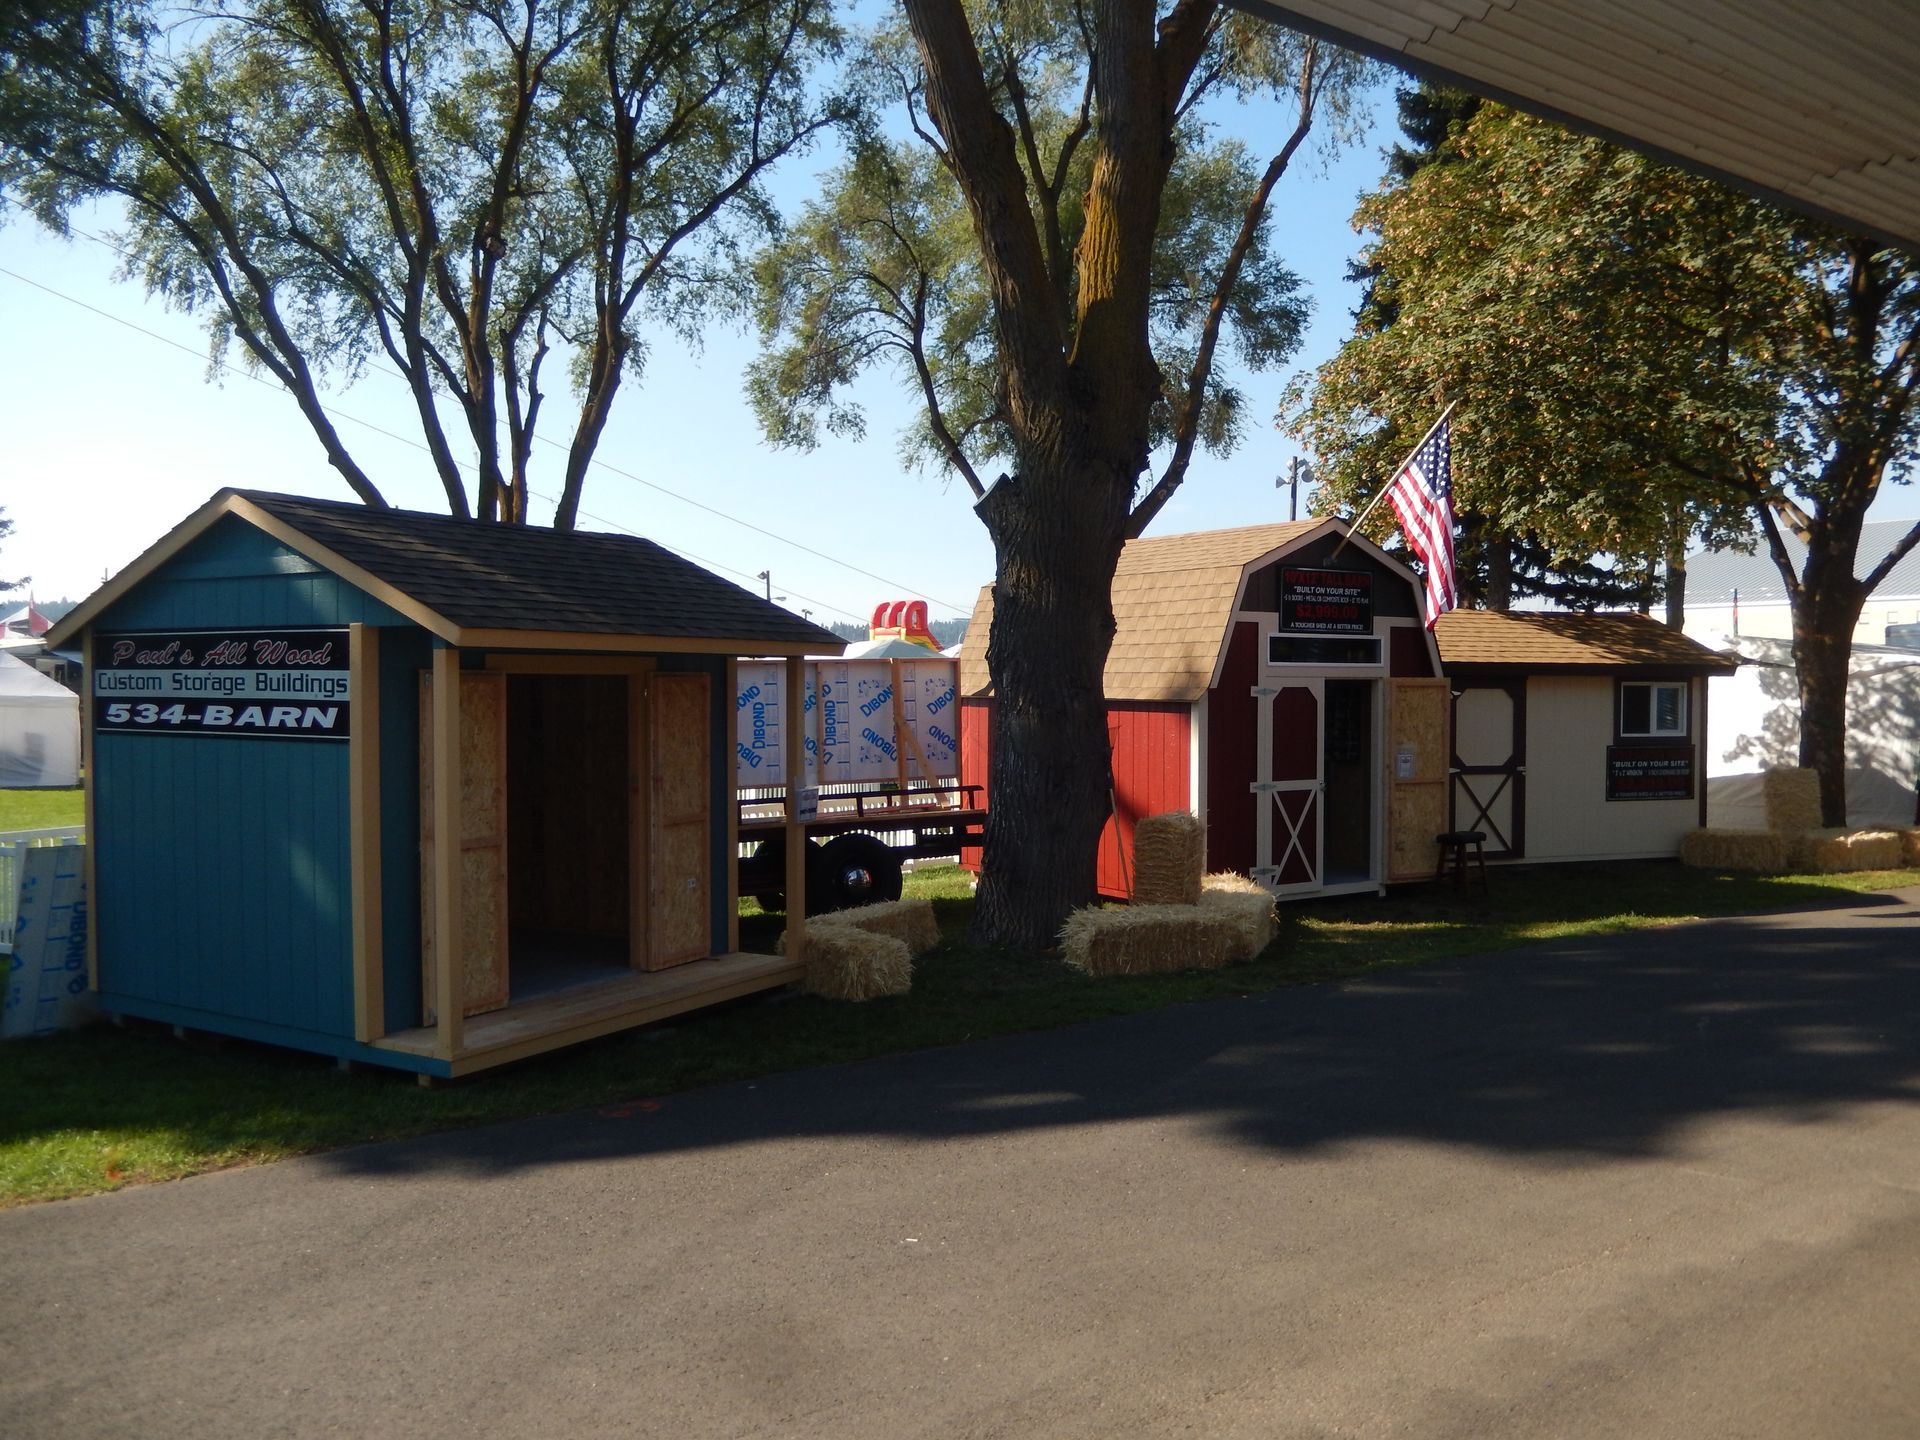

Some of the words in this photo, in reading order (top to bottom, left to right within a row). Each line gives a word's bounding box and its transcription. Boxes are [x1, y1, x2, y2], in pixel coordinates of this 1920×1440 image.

[1315, 586, 1325, 594] ON
[1326, 587, 1344, 595] YOUR
[112, 640, 194, 666] Paul's
[201, 640, 247, 666] All
[254, 640, 333, 666] Wood
[98, 673, 162, 691] Custom
[172, 672, 245, 696] Storage
[255, 673, 348, 698] Buildings
[106, 703, 339, 730] 534-BARN
[752, 702, 766, 749] DIBOND
[824, 699, 837, 746] DIBOND
[1637, 760, 1648, 768] ON
